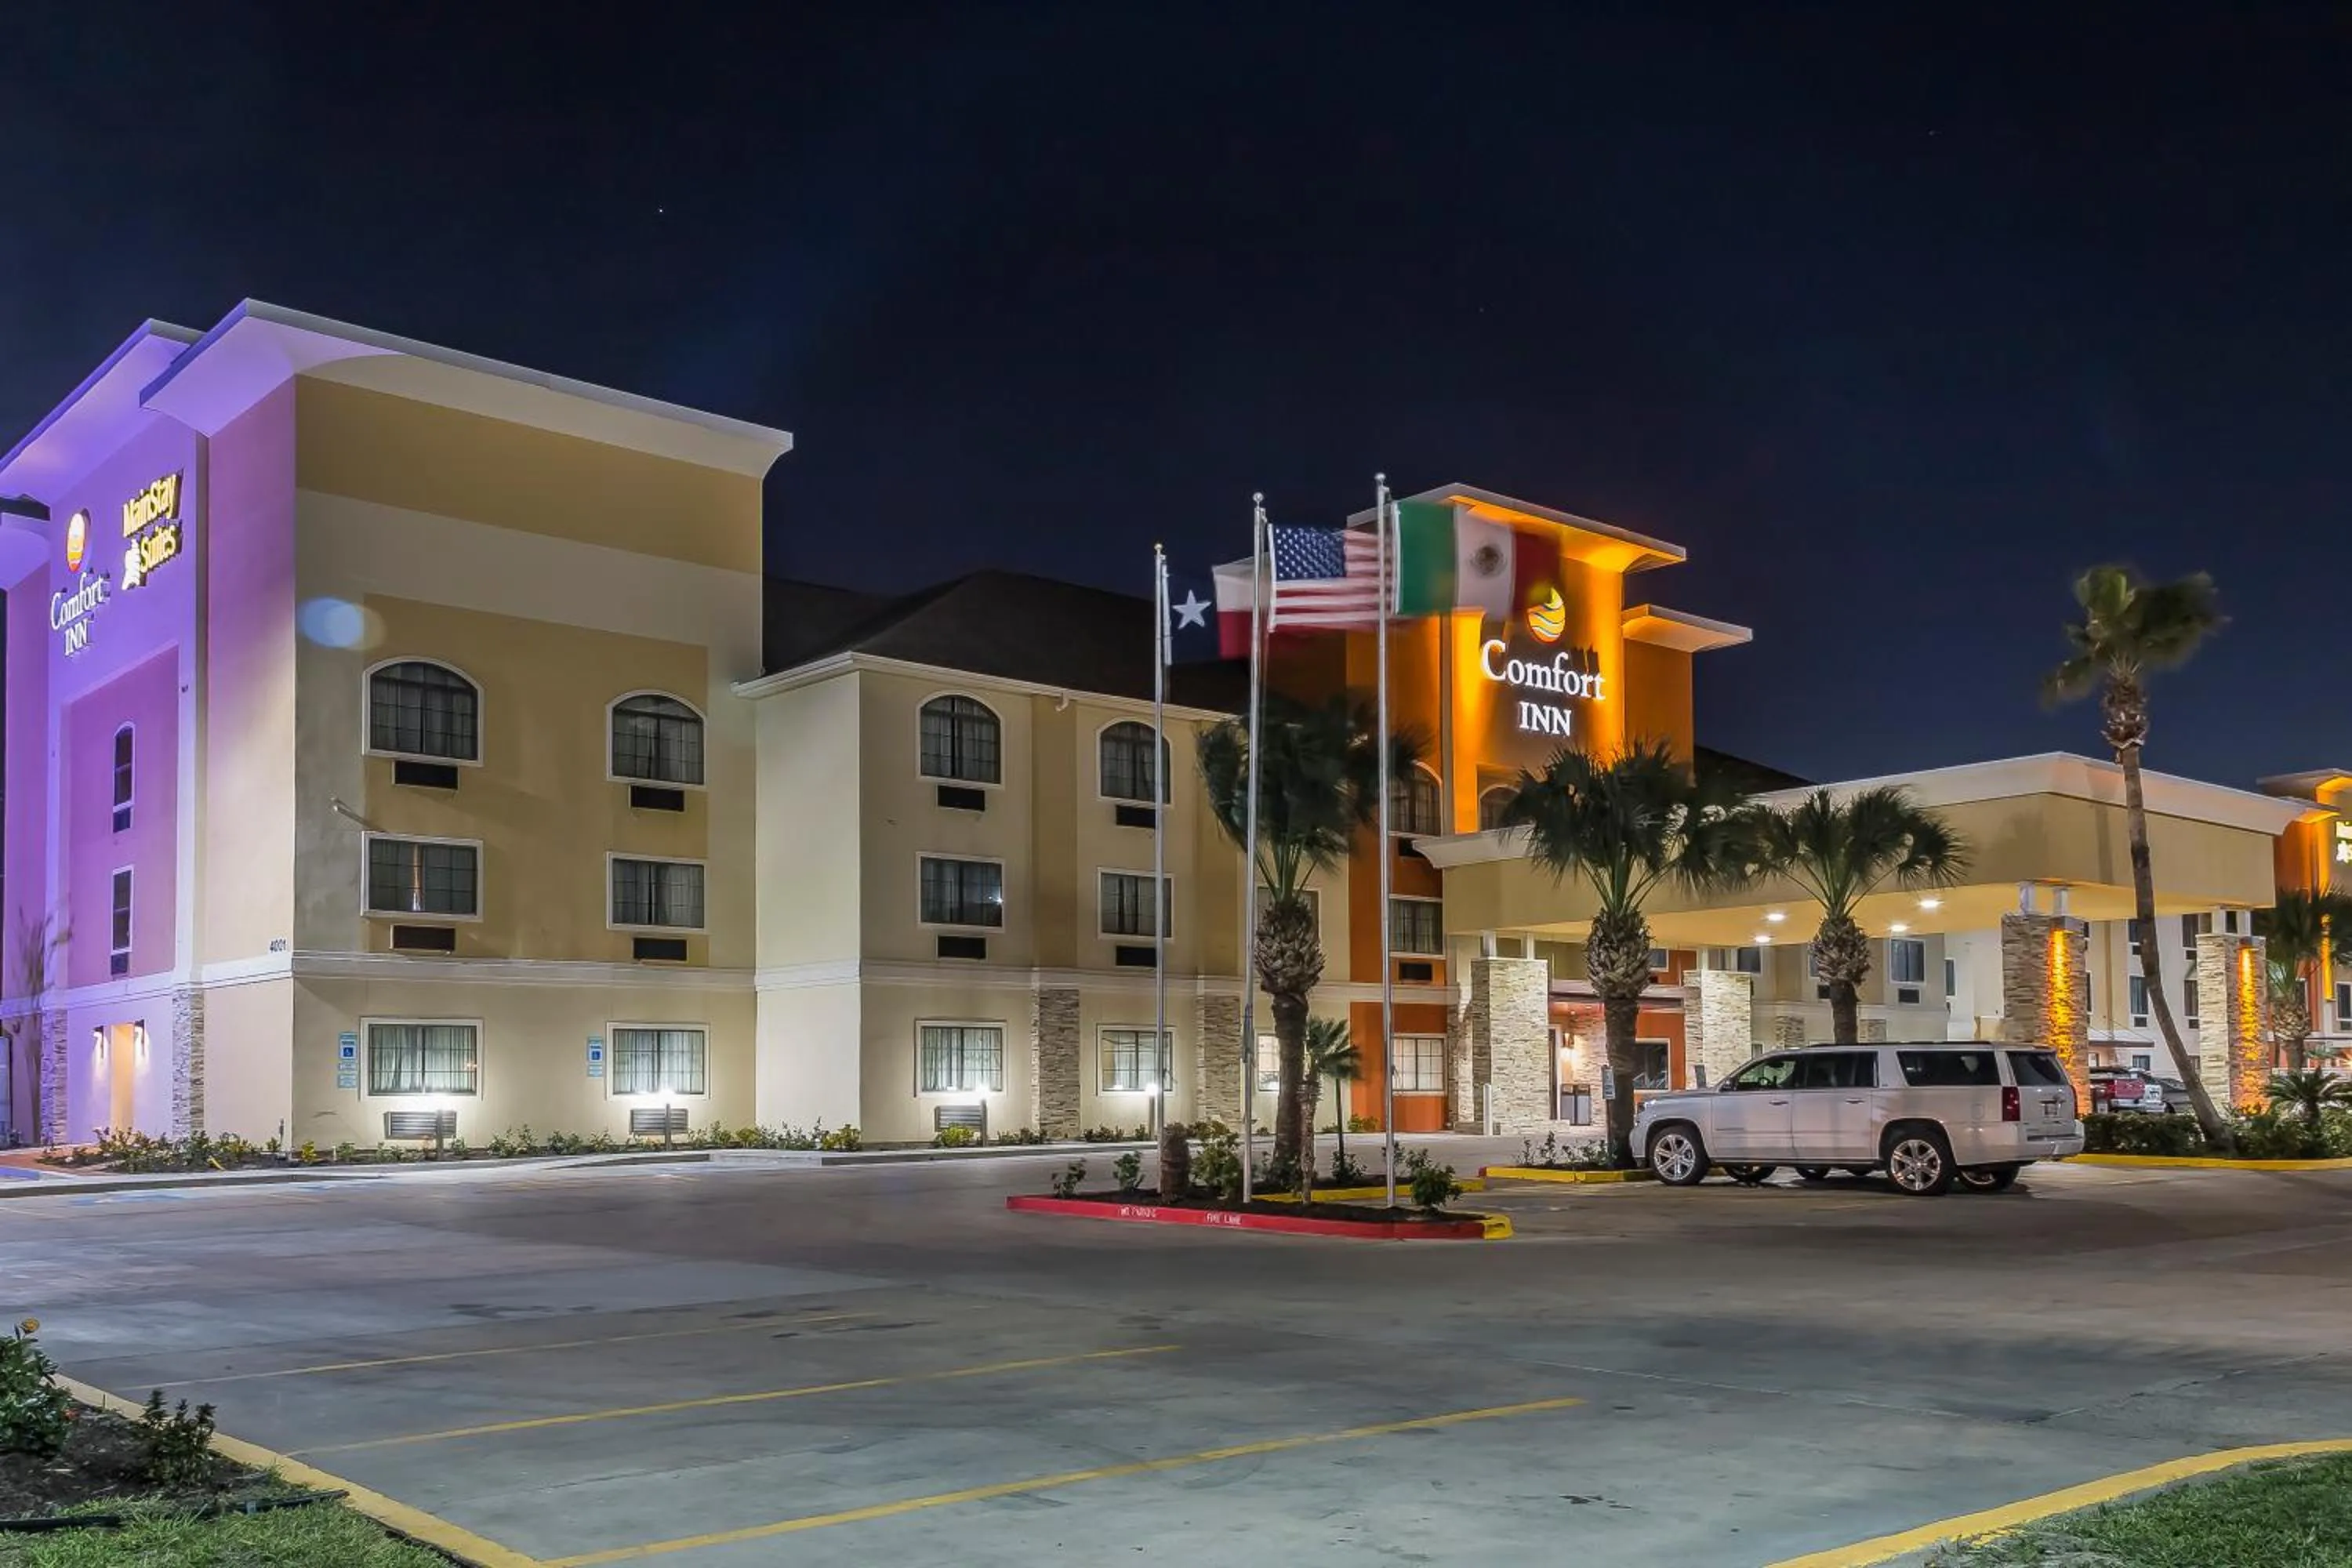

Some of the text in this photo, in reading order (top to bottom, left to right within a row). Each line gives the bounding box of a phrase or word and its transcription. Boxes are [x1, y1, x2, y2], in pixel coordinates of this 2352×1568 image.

[123, 474, 176, 537] MainStay
[140, 524, 176, 572] Suites
[50, 572, 104, 630] Comfort
[64, 619, 87, 655] INN
[1481, 639, 1606, 699] Comfort
[1519, 702, 1571, 735] INN
[270, 938, 286, 952] 4001
